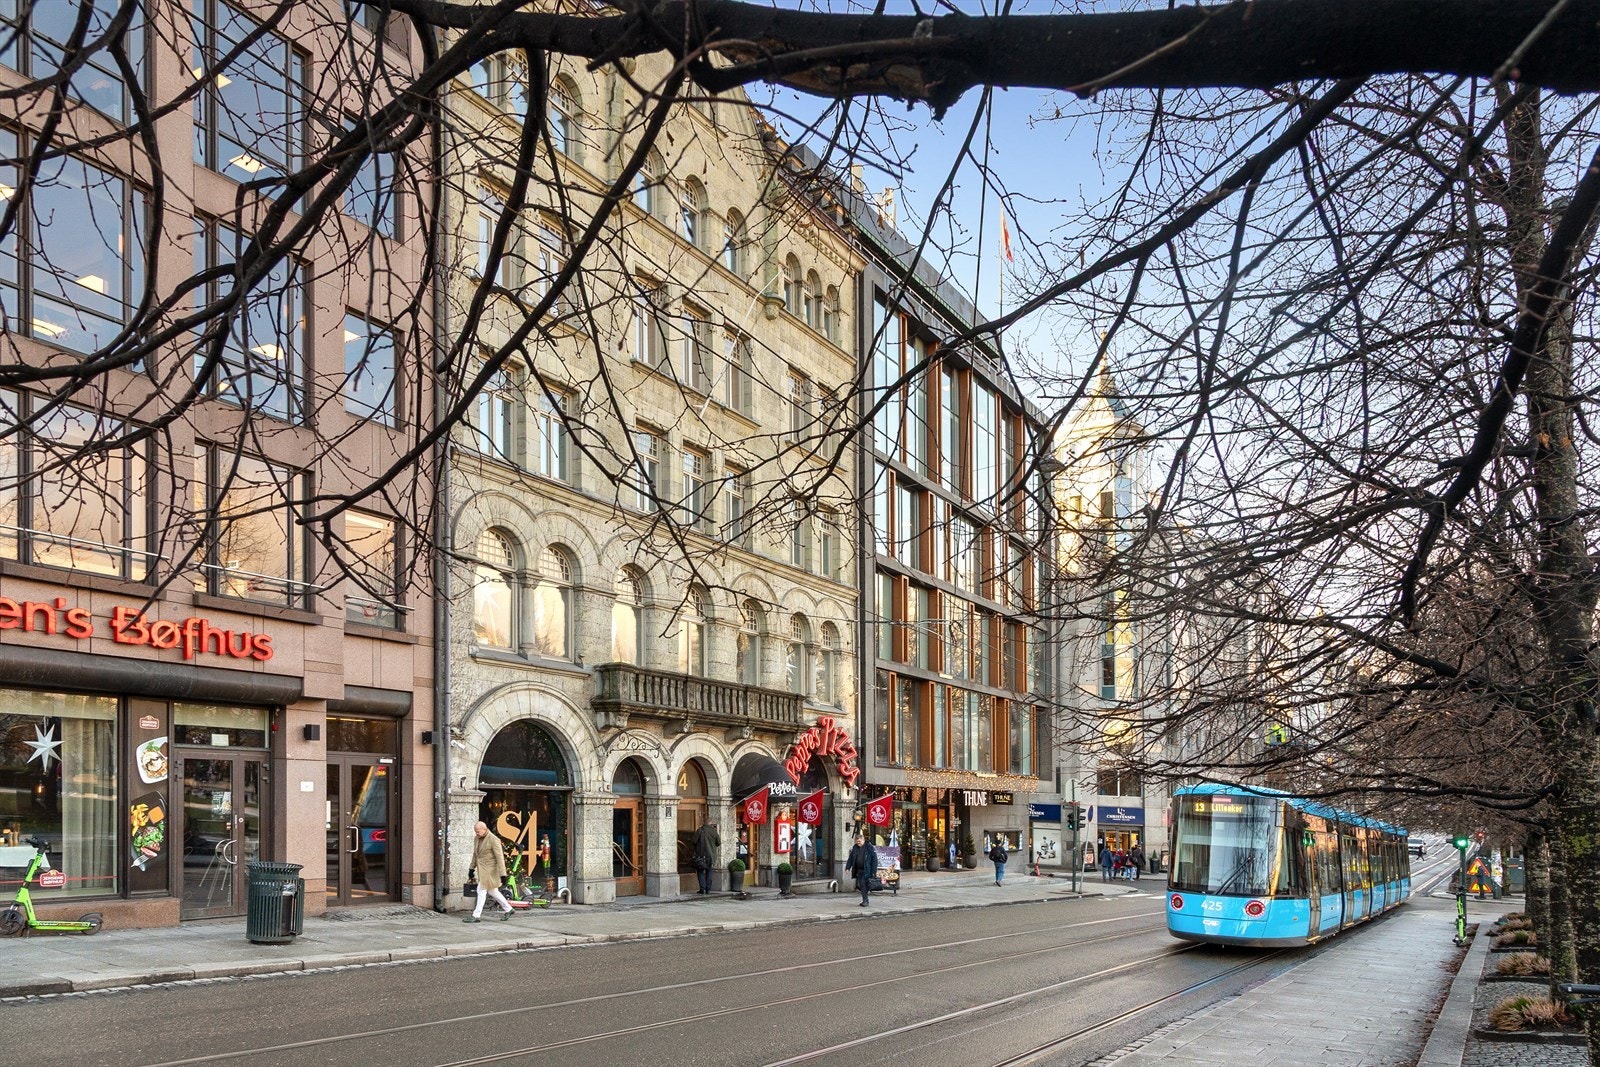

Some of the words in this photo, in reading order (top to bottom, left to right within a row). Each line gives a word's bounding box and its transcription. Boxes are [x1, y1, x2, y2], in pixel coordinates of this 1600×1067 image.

[678, 772, 688, 791] 4
[963, 790, 987, 806] THUNE
[1194, 802, 1205, 812] 13
[1211, 803, 1243, 813] Lilleaker
[1201, 900, 1223, 911] 425
